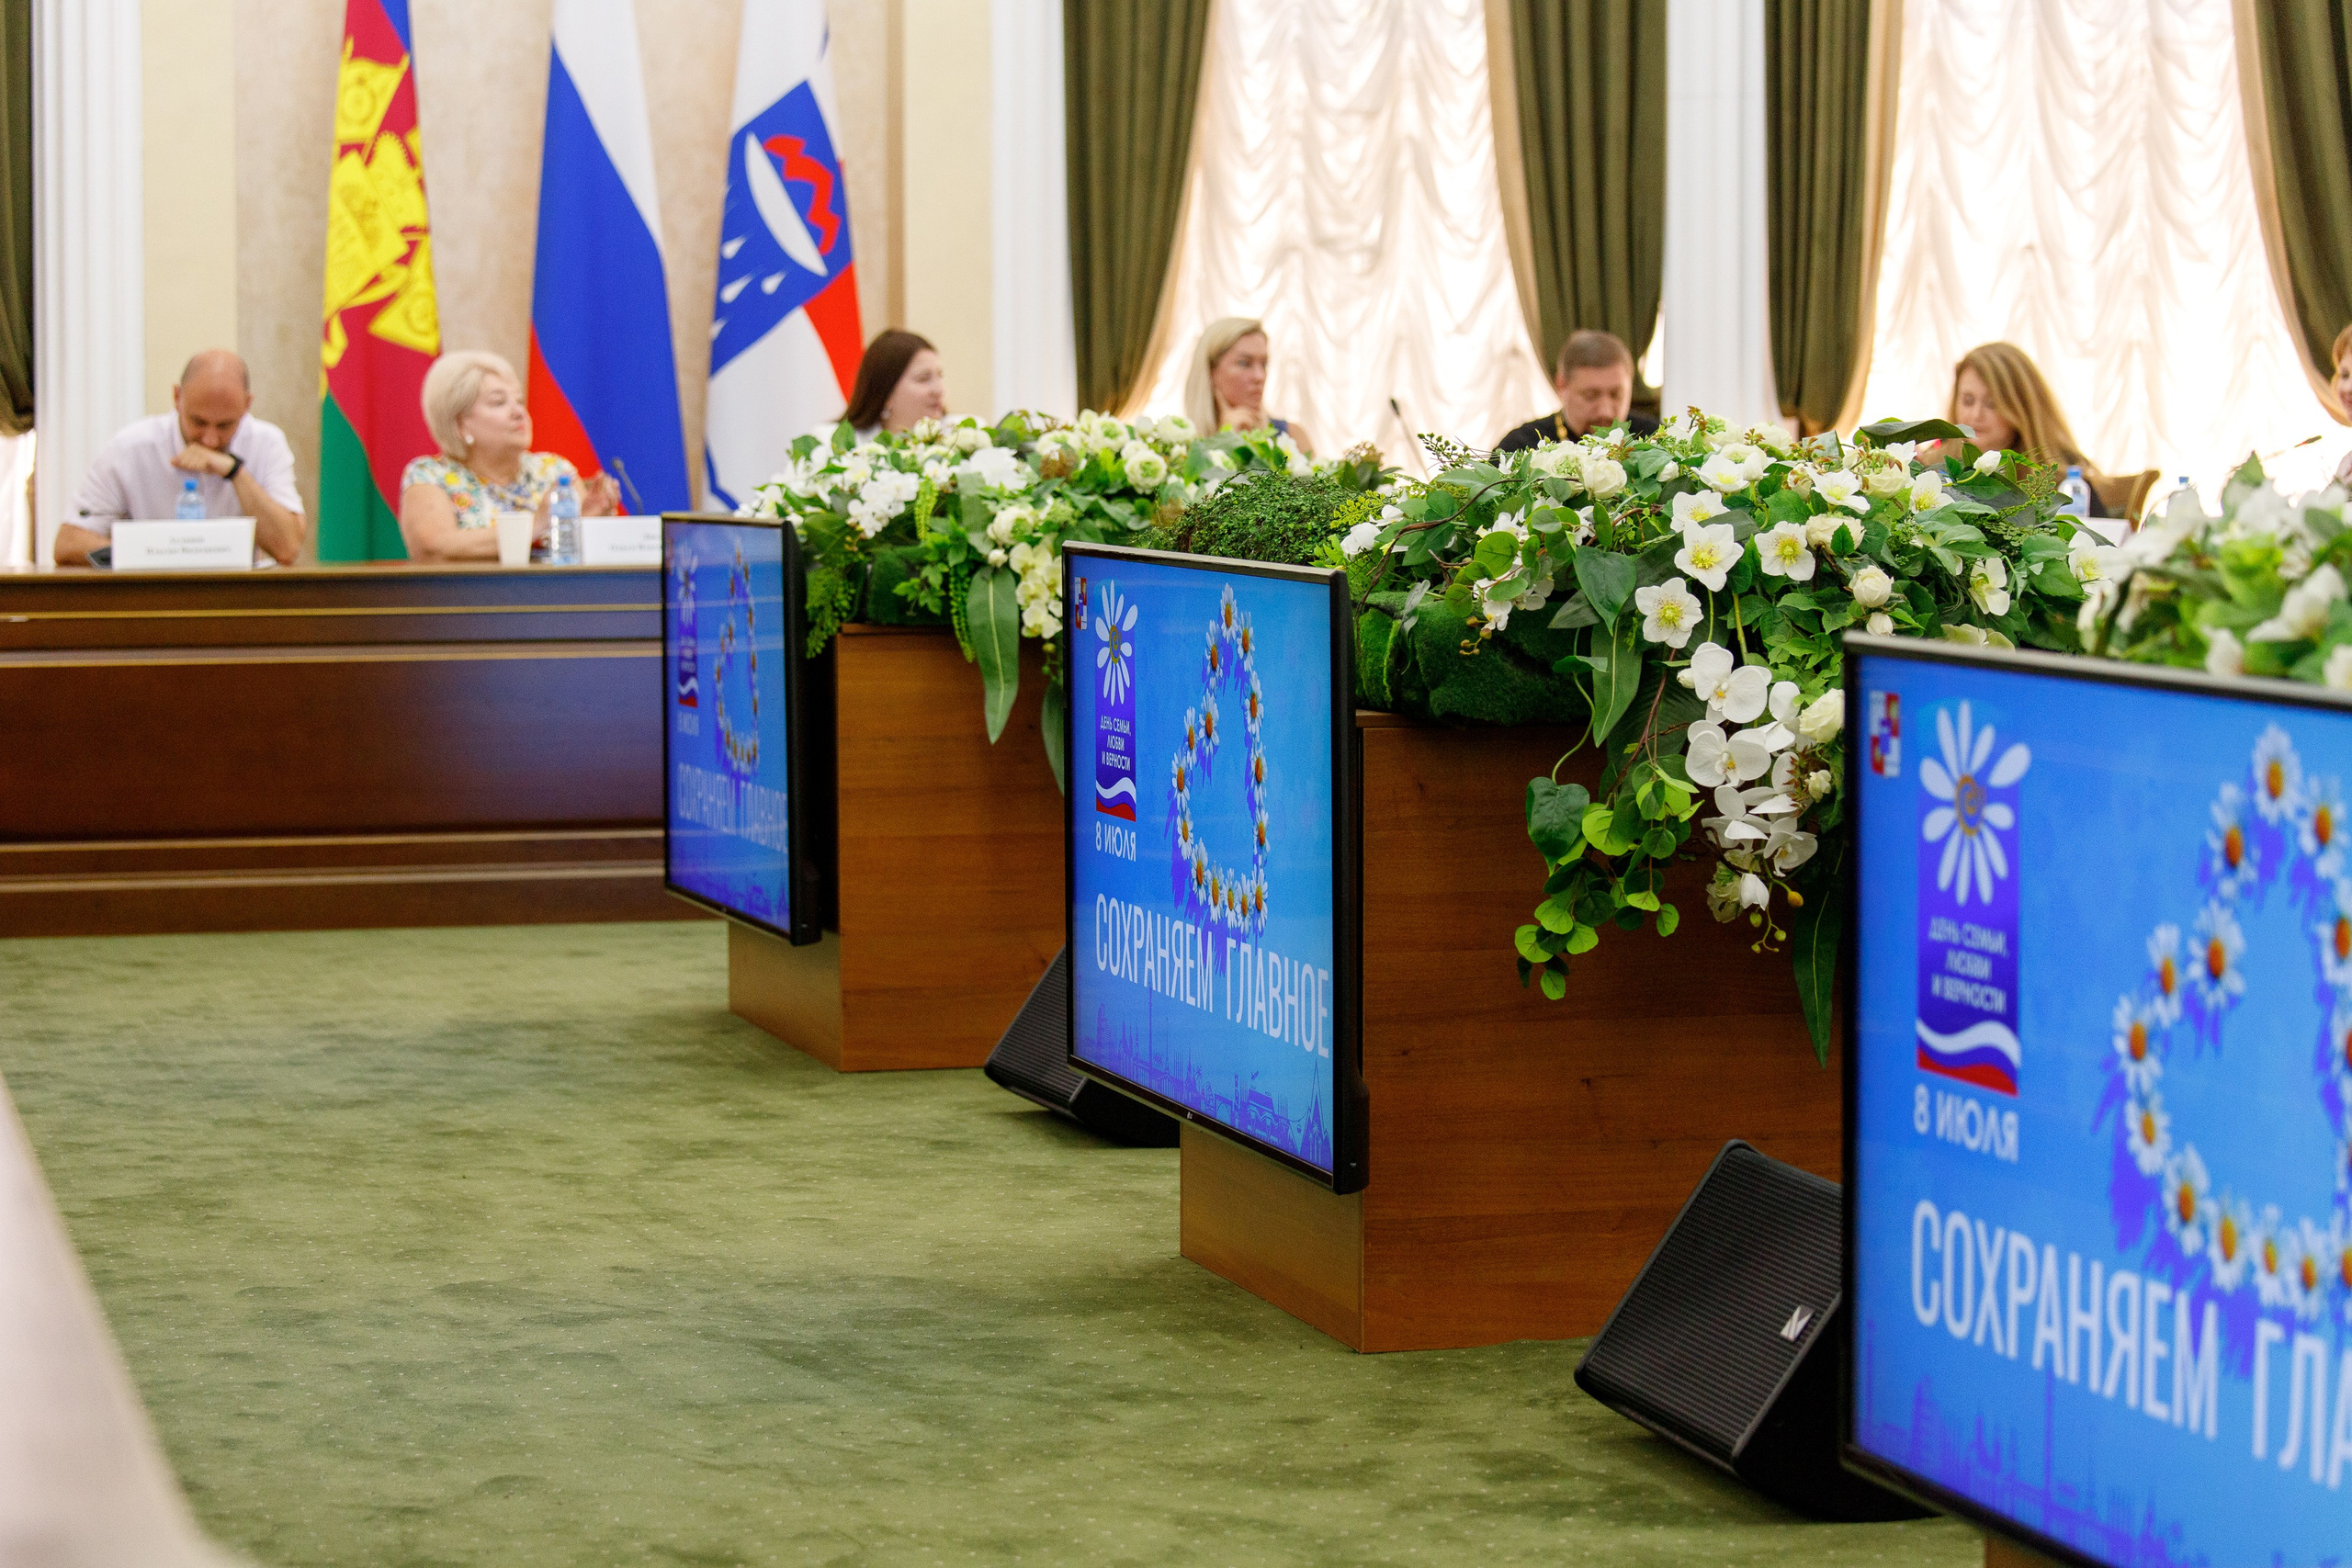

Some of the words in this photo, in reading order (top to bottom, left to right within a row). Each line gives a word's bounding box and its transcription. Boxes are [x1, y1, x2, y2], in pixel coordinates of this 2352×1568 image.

[1100, 715, 1113, 730] ДЕНЬ
[1106, 734, 1125, 751] ЛЮБВИ
[1102, 750, 1106, 765] И
[1106, 751, 1130, 771] ВЕРНОСТИ
[1095, 820, 1102, 852] 8
[1104, 823, 1136, 862] ИЮЛЯ
[1095, 893, 1213, 1013] СОХРАНЯЕМ
[1227, 937, 1329, 1058] ГЛАВНОЕ
[1913, 1083, 1928, 1135] 8
[1936, 1089, 2019, 1163] ИЮЛЯ
[1911, 1200, 2218, 1441] СОХРАНЯЕМ
